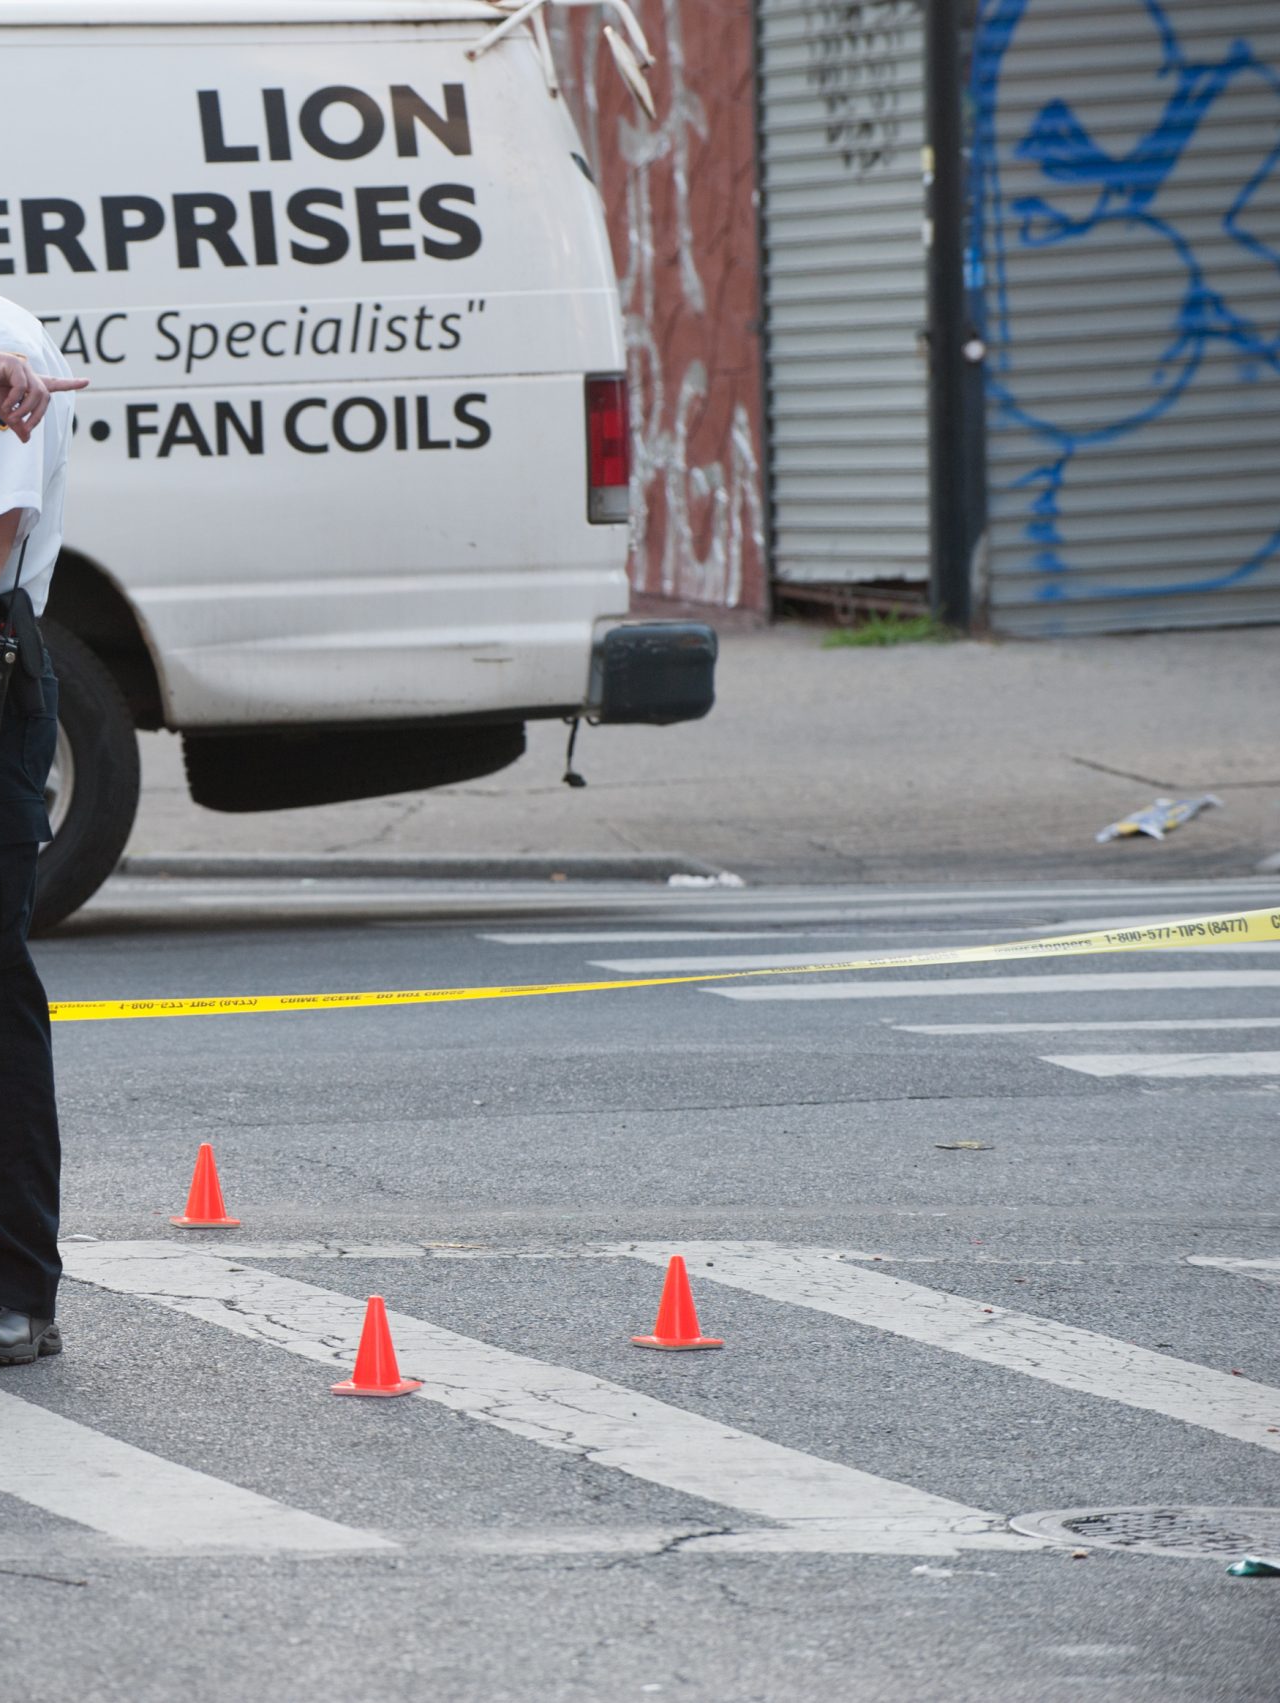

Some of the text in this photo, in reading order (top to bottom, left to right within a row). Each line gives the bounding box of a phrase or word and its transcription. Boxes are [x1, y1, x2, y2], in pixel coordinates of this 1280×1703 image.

[196, 82, 473, 163] LION
[283, 392, 493, 455] COILS
[1104, 921, 1206, 944] 1-800-577-TIPS
[1207, 917, 1248, 937] (8477)
